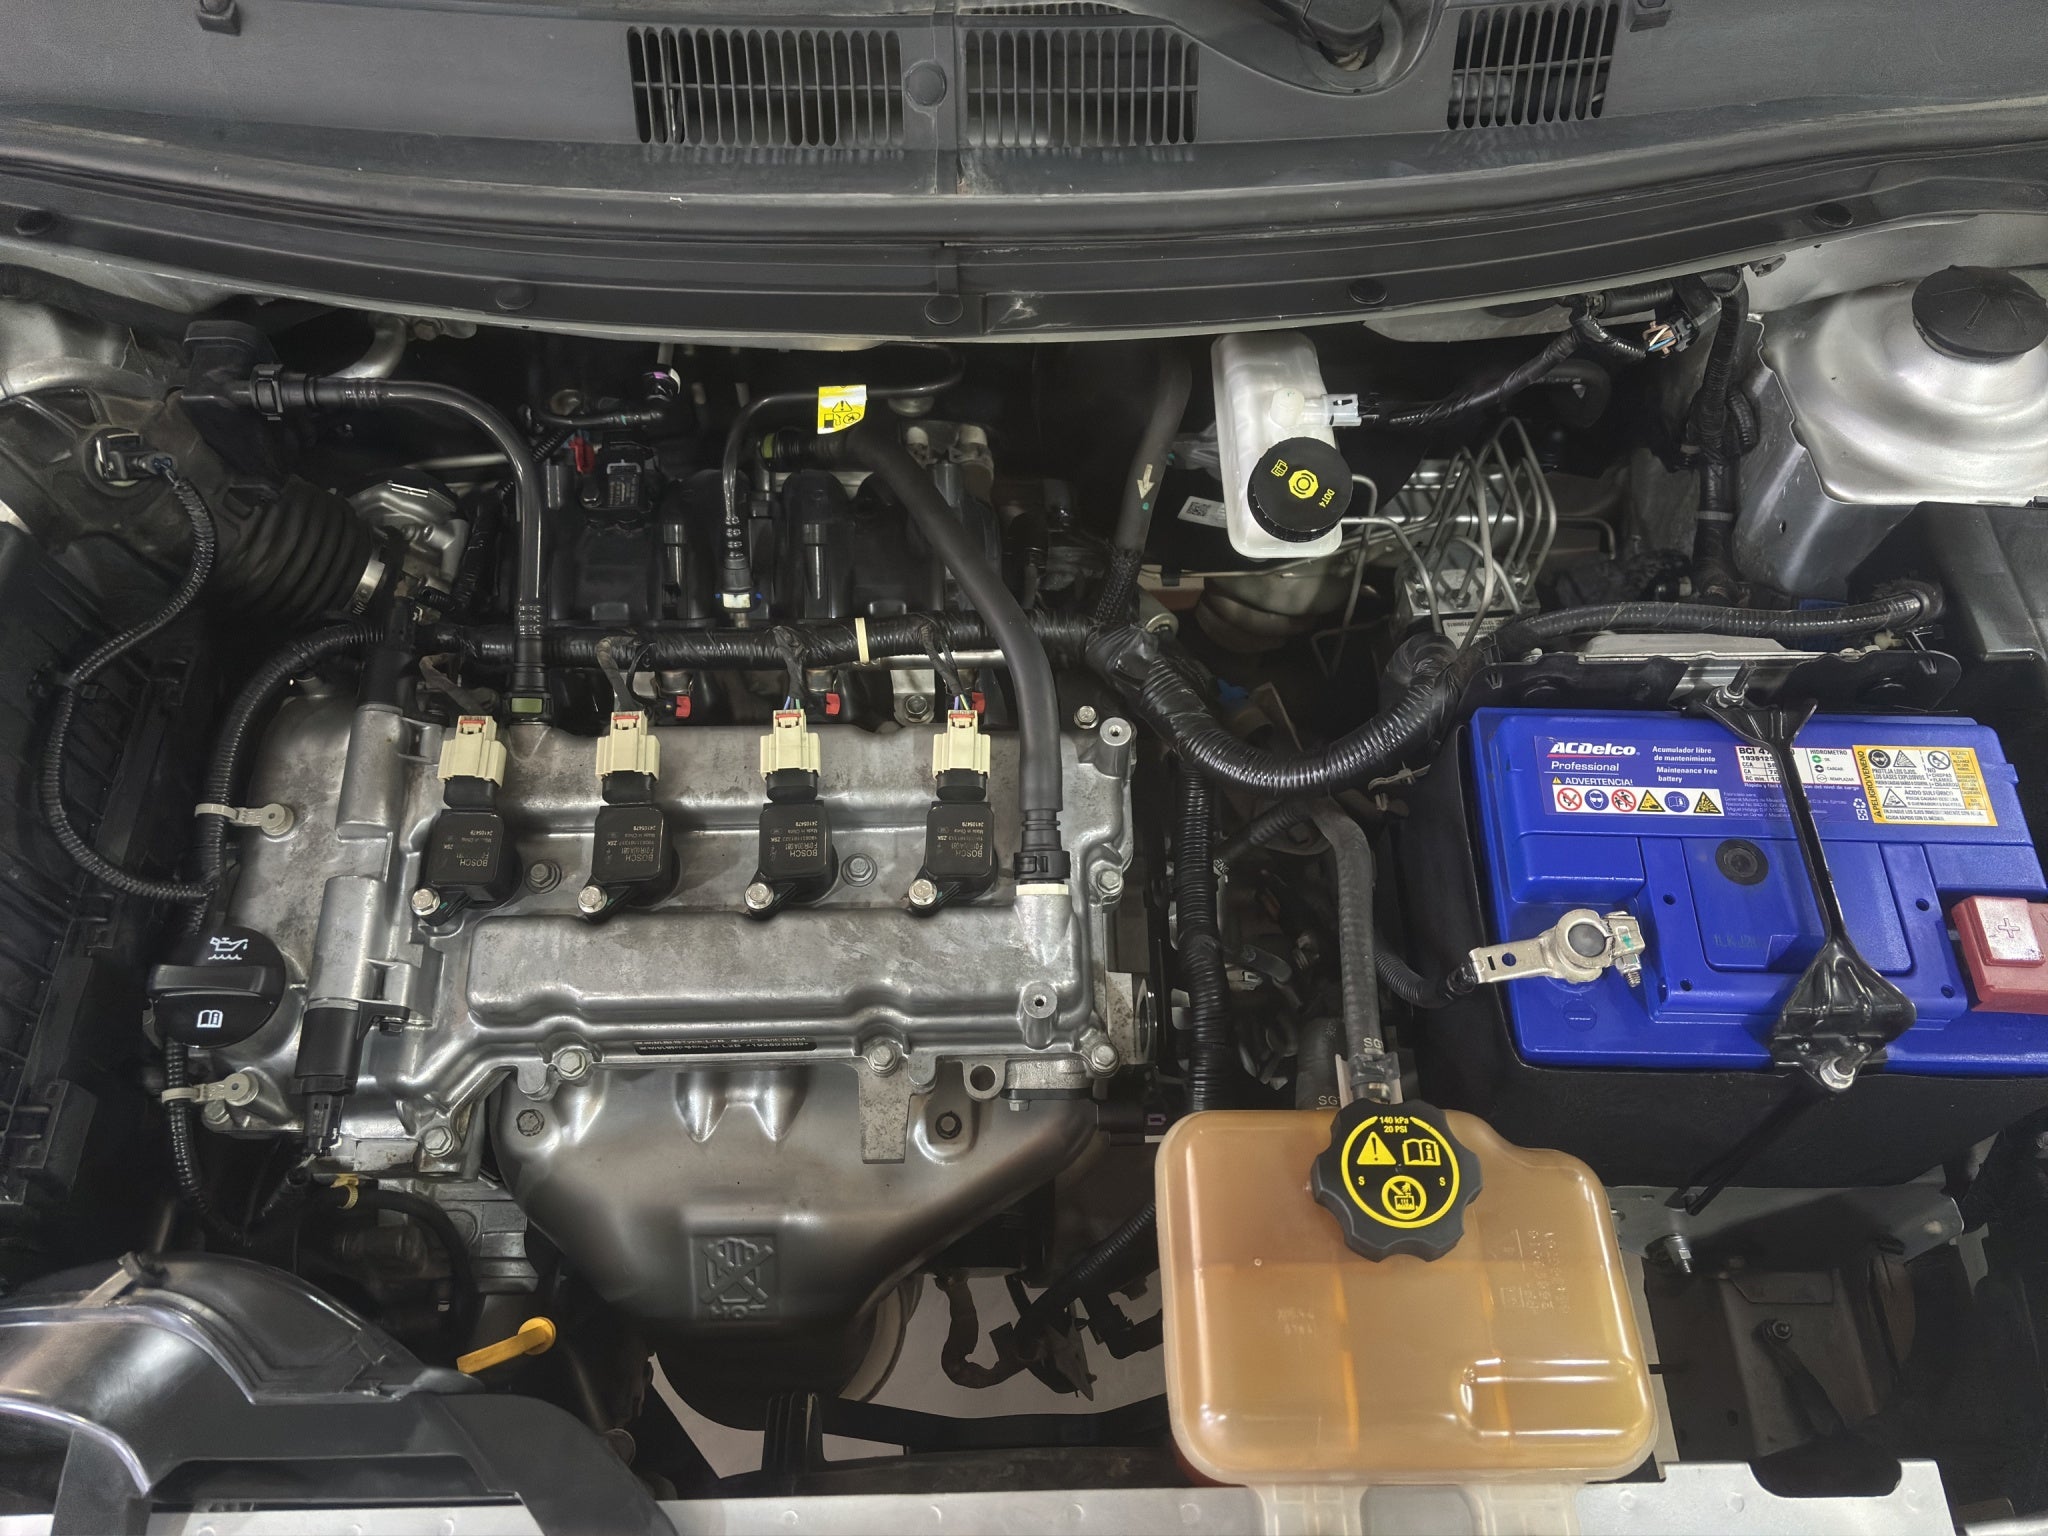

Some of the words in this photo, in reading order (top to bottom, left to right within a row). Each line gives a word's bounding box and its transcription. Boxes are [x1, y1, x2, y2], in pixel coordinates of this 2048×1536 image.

[1319, 488, 1335, 508] DOT4
[1550, 742, 1636, 756] ACDelco
[1652, 746, 1694, 754] Acumulador
[1551, 761, 1619, 772] Professional
[1656, 766, 1702, 774] Maintenance
[1704, 767, 1718, 775] free
[1565, 777, 1633, 786] ADVERTENCIA!
[1658, 775, 1682, 783] battery
[1318, 1095, 1340, 1106] SG
[1379, 1116, 1394, 1124] 140
[1395, 1116, 1409, 1124] kPa
[1384, 1125, 1394, 1133] 20
[1358, 1176, 1365, 1185] S
[1439, 1177, 1446, 1186] S
